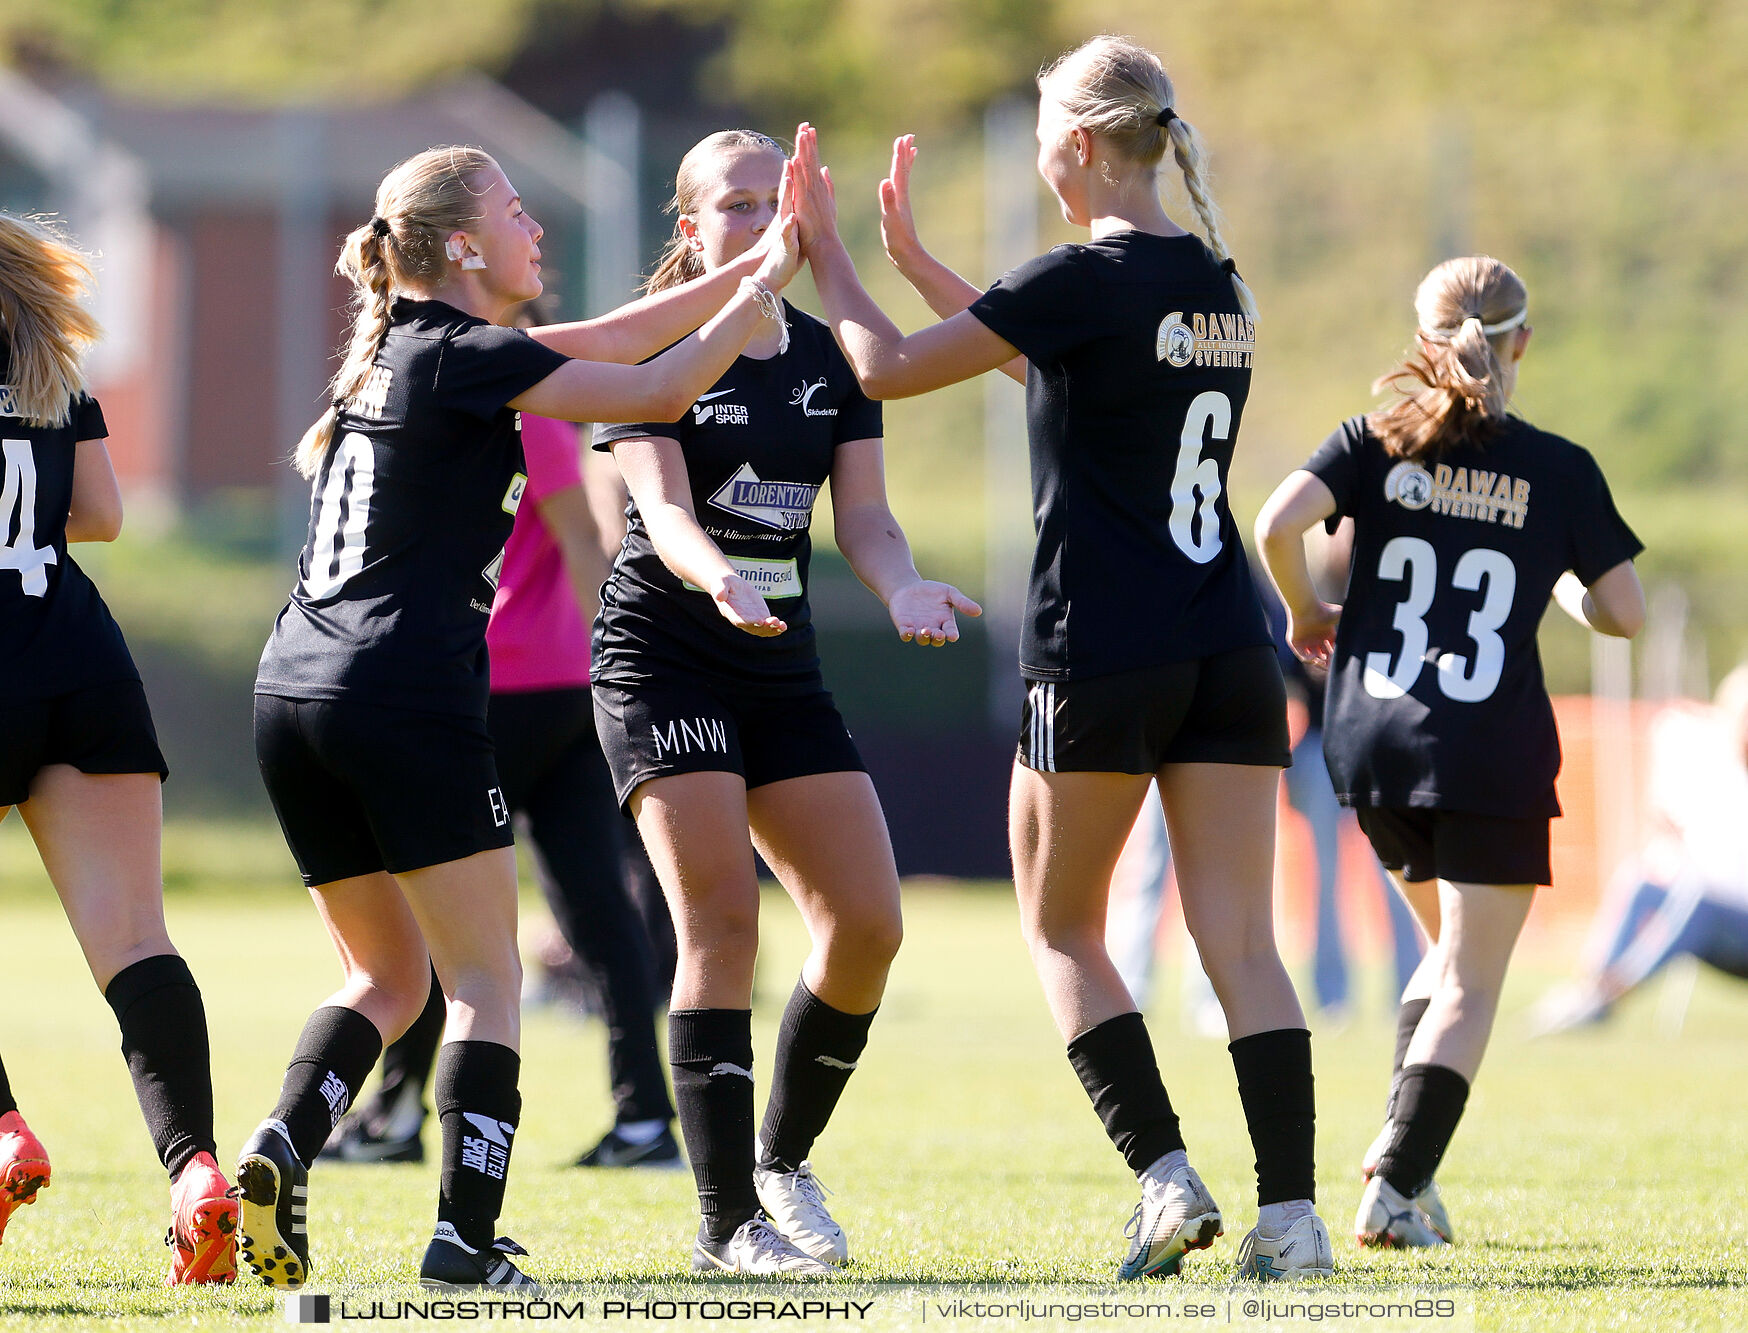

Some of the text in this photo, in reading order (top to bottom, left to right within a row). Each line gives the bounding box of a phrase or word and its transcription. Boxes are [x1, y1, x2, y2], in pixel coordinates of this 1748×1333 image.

[1193, 312, 1255, 342] DAWAB
[1195, 350, 1242, 368] SVERIGE
[714, 404, 748, 416] INTER
[715, 414, 749, 425] SPORT
[1169, 391, 1231, 563] 6
[1434, 463, 1531, 504] DAWAB
[0, 439, 57, 598] 4
[704, 525, 722, 537] Det
[1430, 498, 1498, 523] SVERIGE
[1502, 509, 1526, 530] AB
[1363, 537, 1517, 703] 33
[651, 717, 727, 759] MNW
[462, 1136, 490, 1174] SPORT
[487, 1144, 508, 1179] INTER
